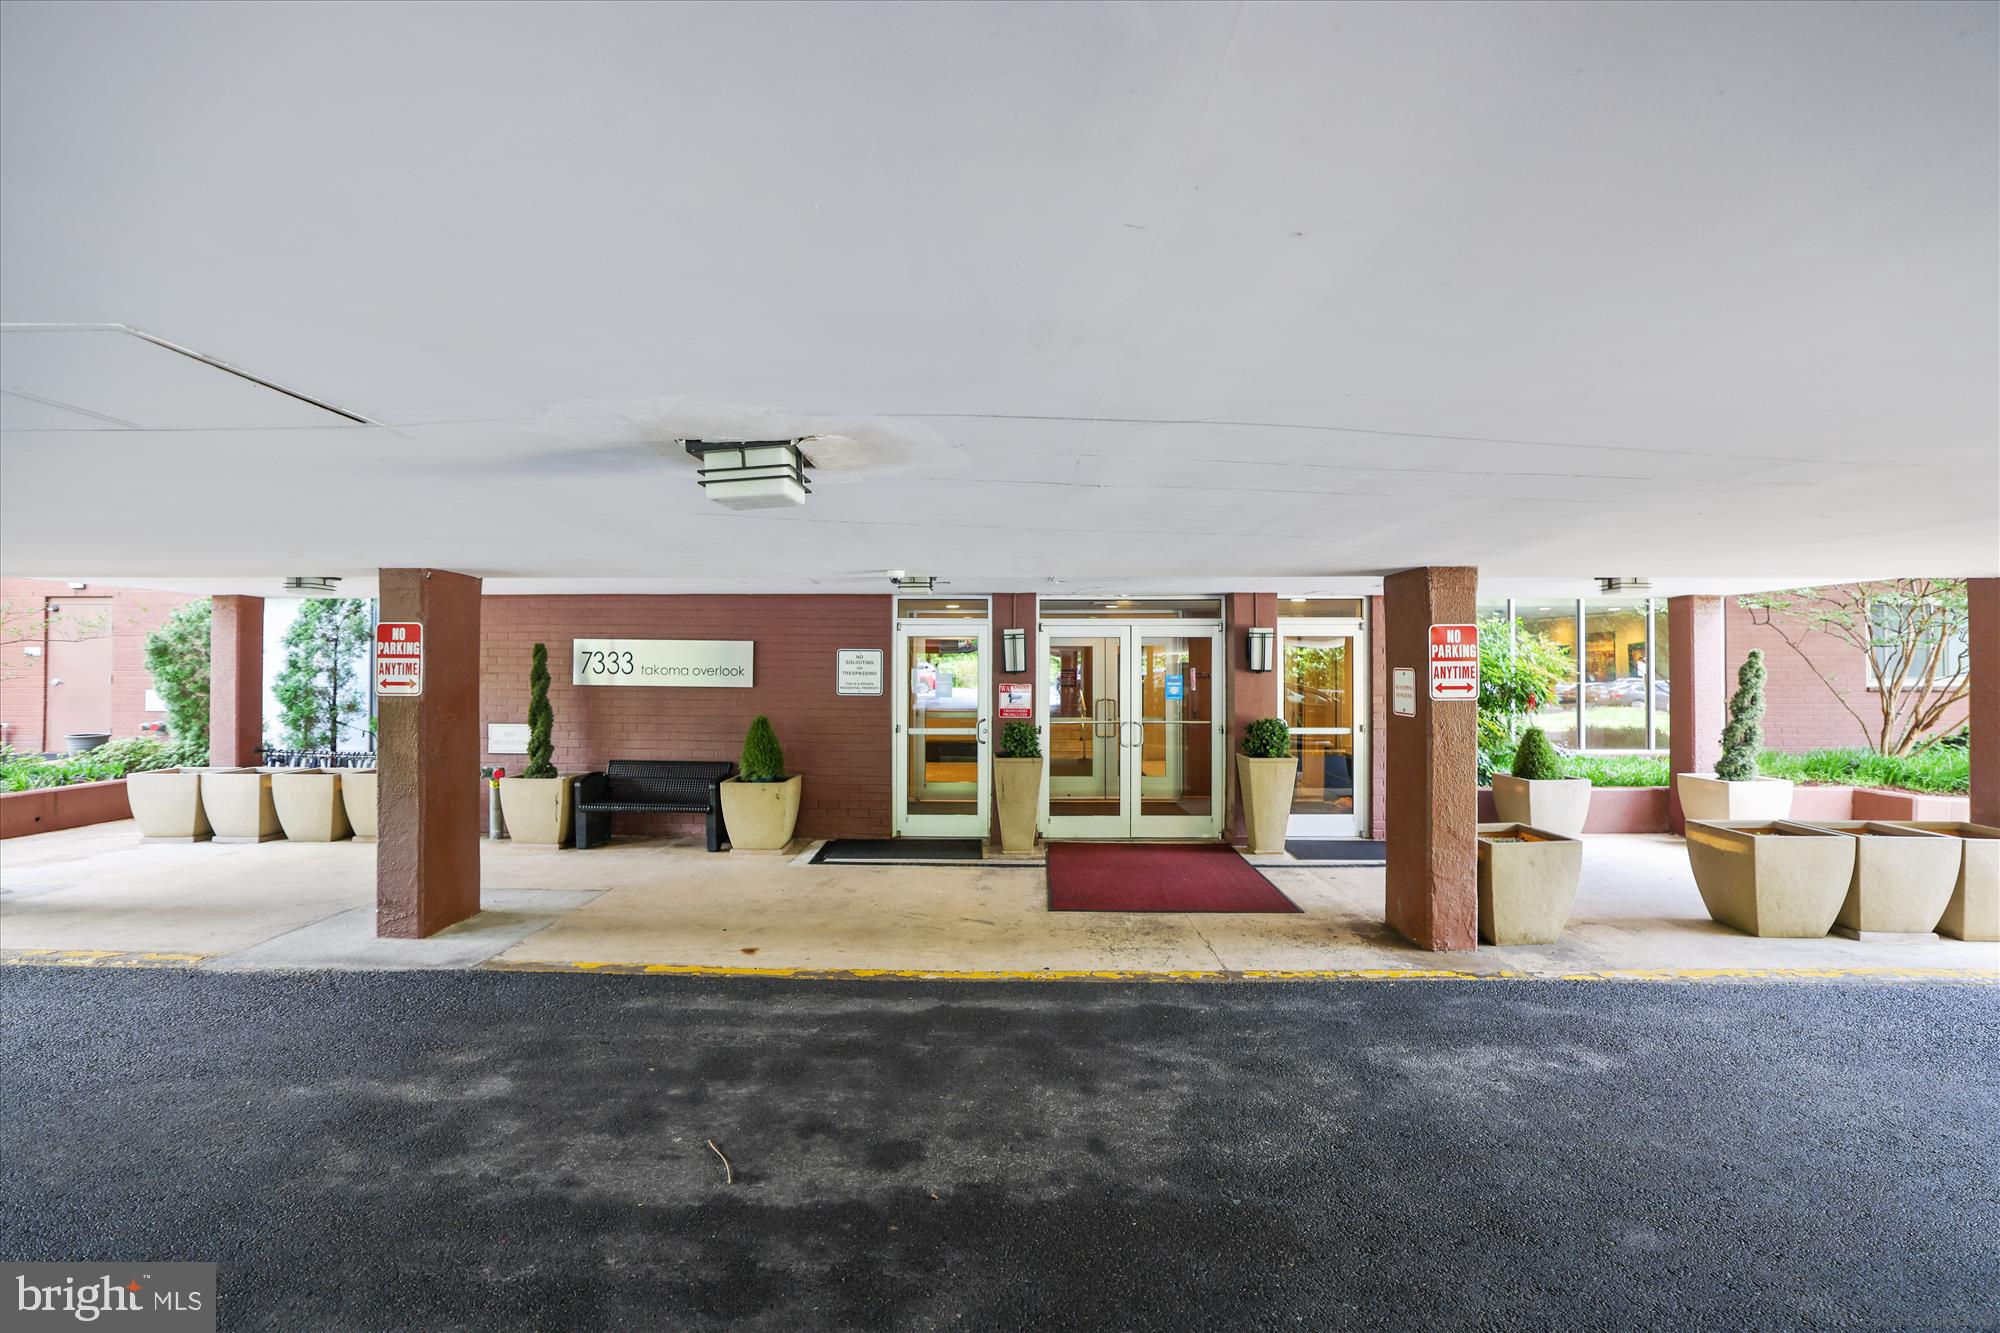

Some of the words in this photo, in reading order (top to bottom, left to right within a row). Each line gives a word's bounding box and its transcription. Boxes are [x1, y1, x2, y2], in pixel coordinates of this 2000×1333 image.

[392, 627, 406, 641] NO
[1446, 629, 1461, 644] NO
[377, 641, 420, 655] PARKING
[1431, 644, 1477, 658] PARKING
[379, 662, 418, 676] ANYTIME
[581, 651, 634, 675] 7333
[641, 664, 689, 677] takoma
[692, 665, 745, 677] overlook
[1433, 665, 1475, 680] ANYTIME
